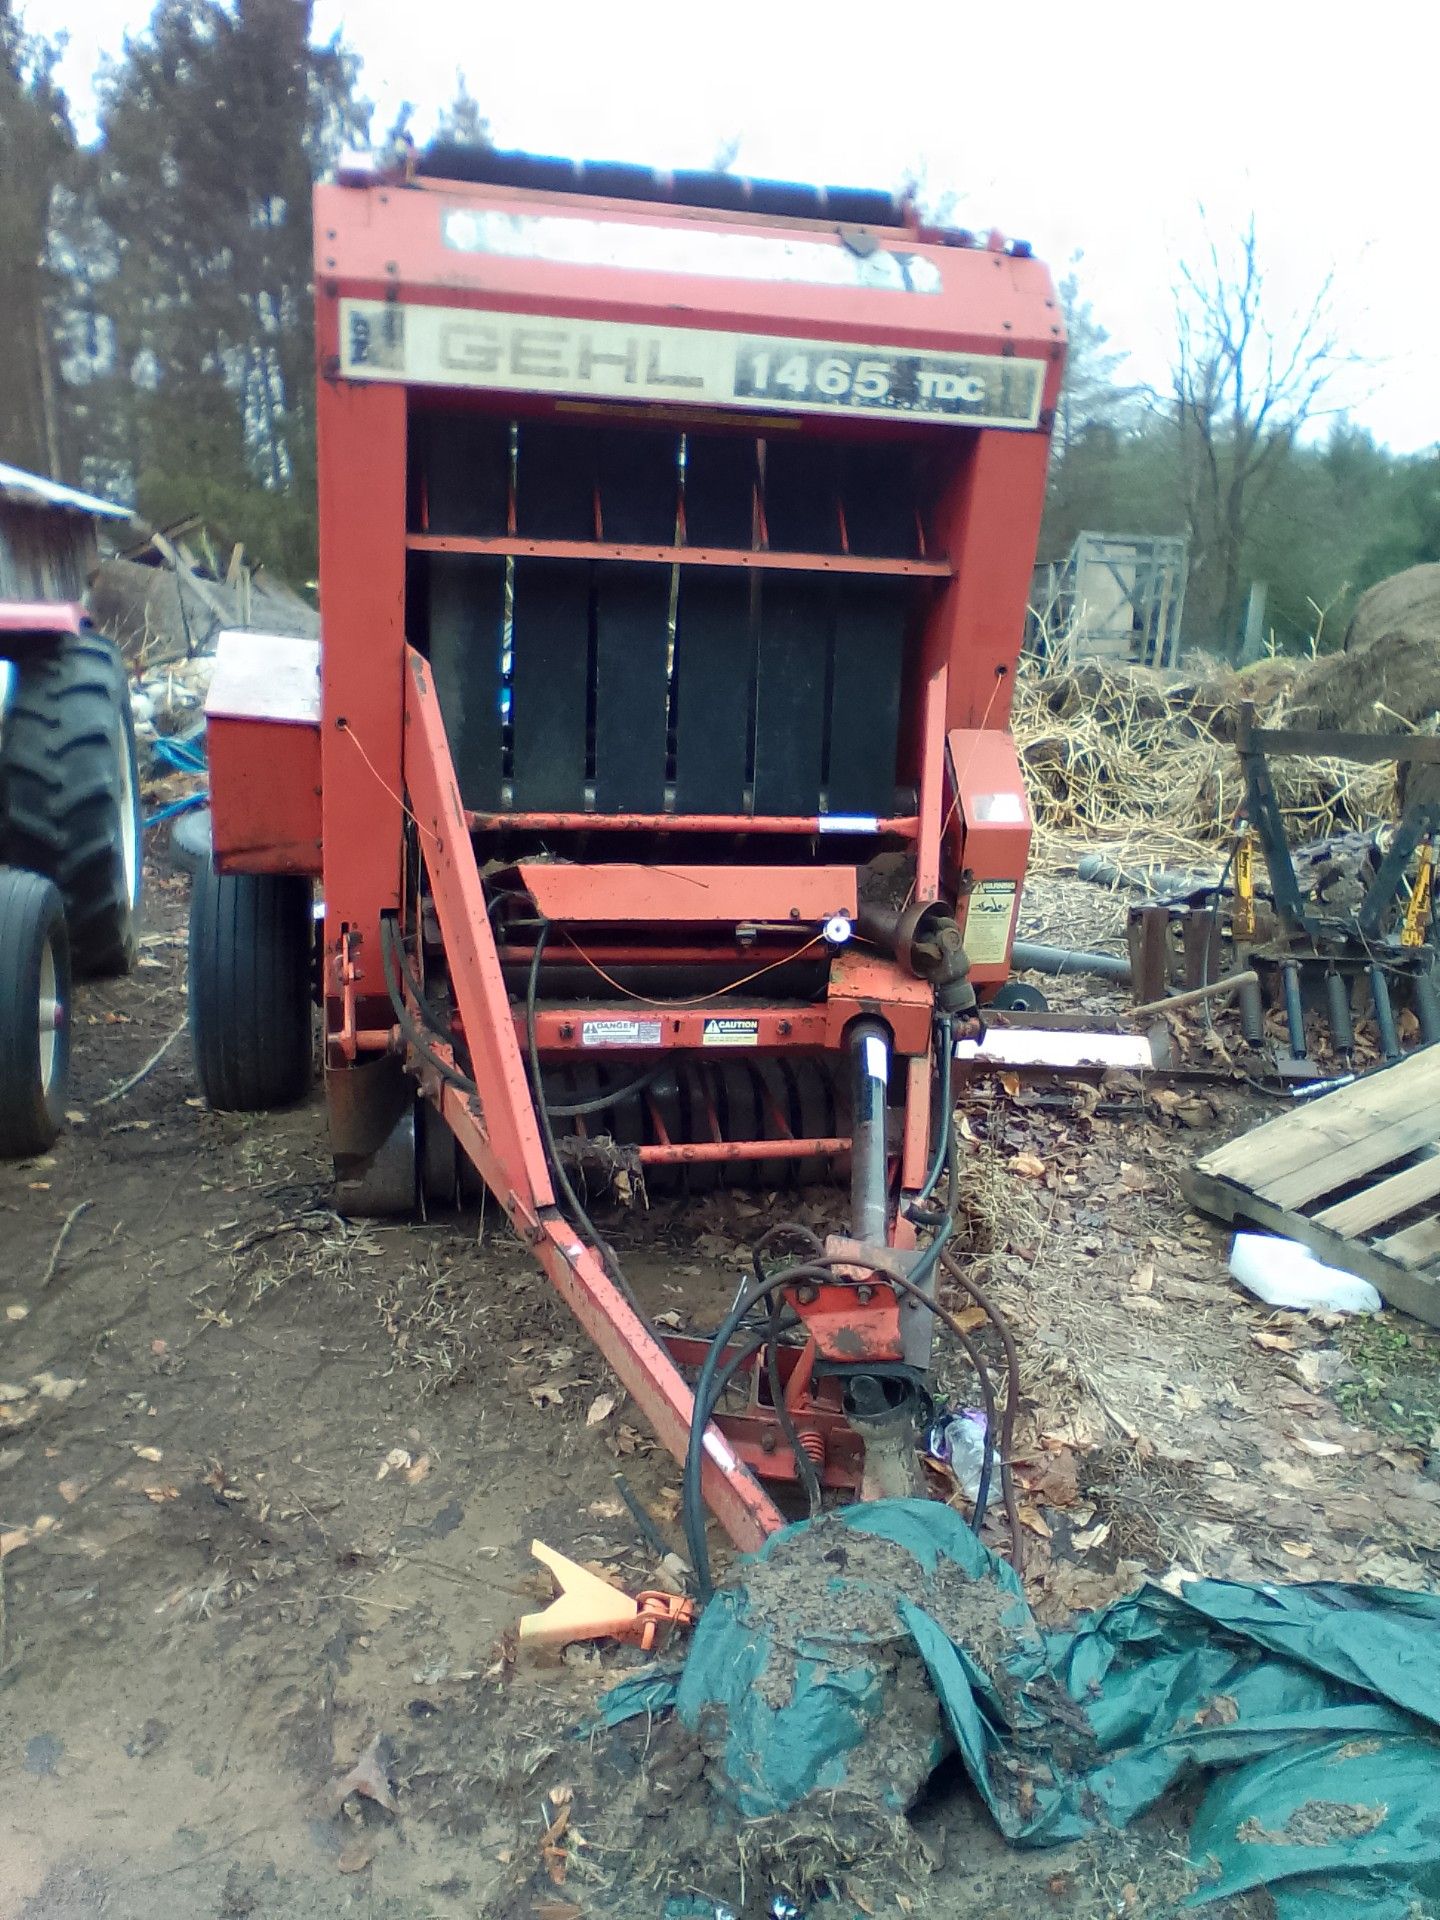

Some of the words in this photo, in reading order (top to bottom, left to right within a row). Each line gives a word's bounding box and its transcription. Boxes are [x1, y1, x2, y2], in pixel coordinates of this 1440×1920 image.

[439, 322, 704, 388] GEHL
[752, 350, 891, 399] 1465
[915, 371, 986, 402] TDC
